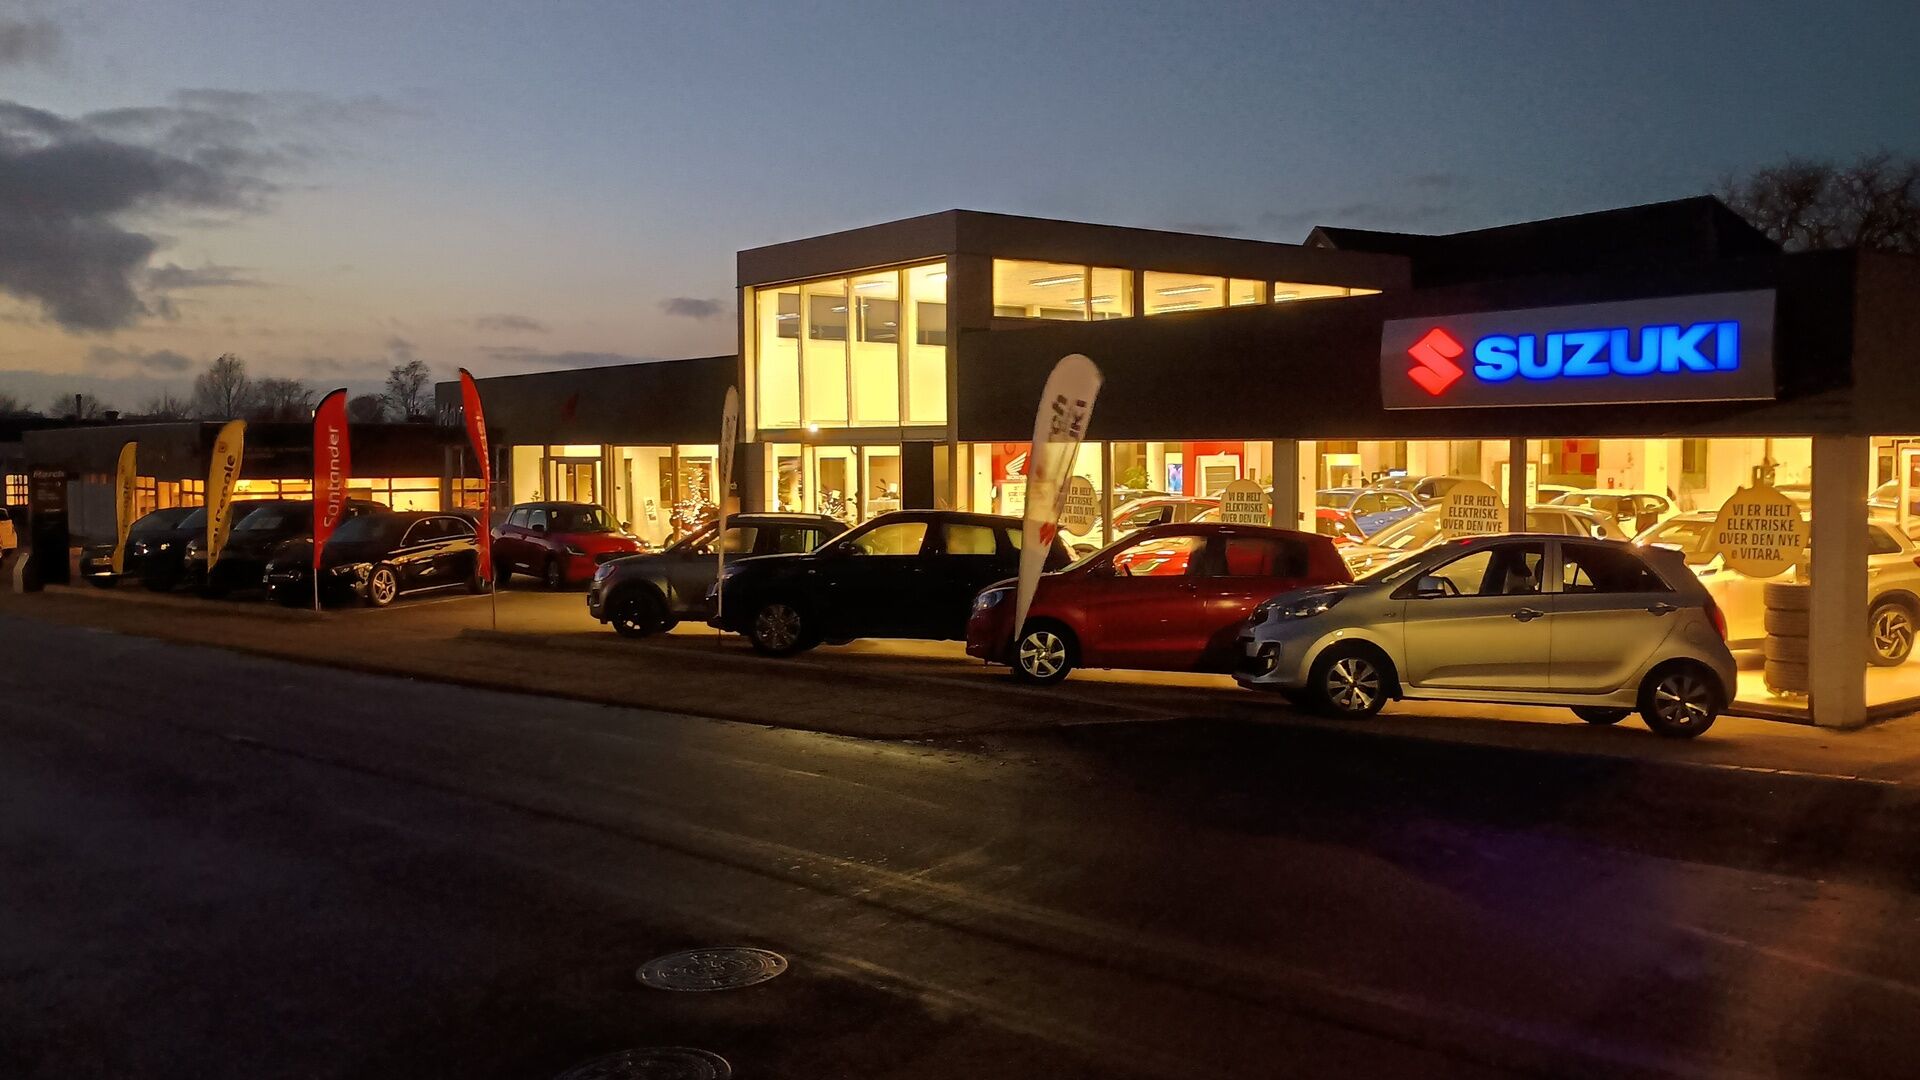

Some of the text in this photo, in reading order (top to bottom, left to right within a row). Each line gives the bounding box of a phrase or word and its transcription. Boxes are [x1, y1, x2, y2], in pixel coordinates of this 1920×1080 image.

[1474, 320, 1740, 382] SUZUKI
[324, 425, 340, 528] Santander
[1228, 492, 1262, 502] VI ER HELT
[1453, 494, 1497, 507] VI ER HELT
[1226, 502, 1263, 513] ELEKTRISKE
[1448, 506, 1498, 519] ELEKTRISKE
[1733, 504, 1792, 517] VI ER HELT
[1222, 514, 1266, 524] OVER DEN NYE
[1442, 519, 1503, 532] OVER DEN NYE
[1728, 518, 1794, 532] ELEKTRISKE
[1720, 532, 1800, 546] OVER DEN NYE
[1740, 548, 1784, 560] VITARA.
